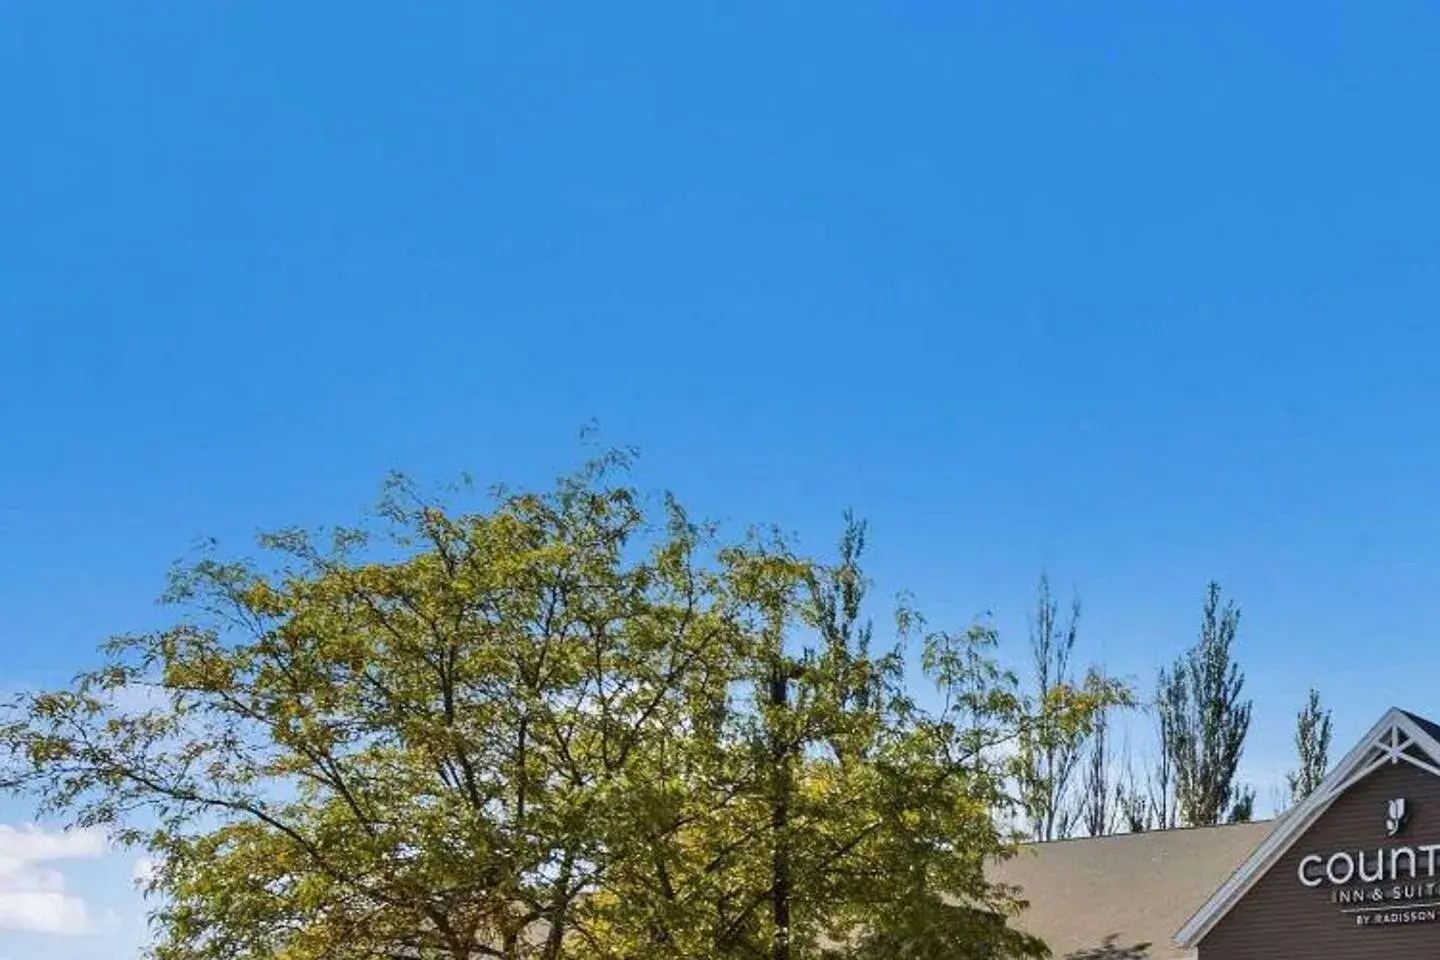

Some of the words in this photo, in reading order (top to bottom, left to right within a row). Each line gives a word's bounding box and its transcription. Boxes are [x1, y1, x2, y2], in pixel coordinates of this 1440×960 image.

[1331, 889, 1365, 904] INN
[1371, 888, 1383, 901] &
[1356, 914, 1370, 925] BY
[1374, 910, 1436, 925] RADISSON
